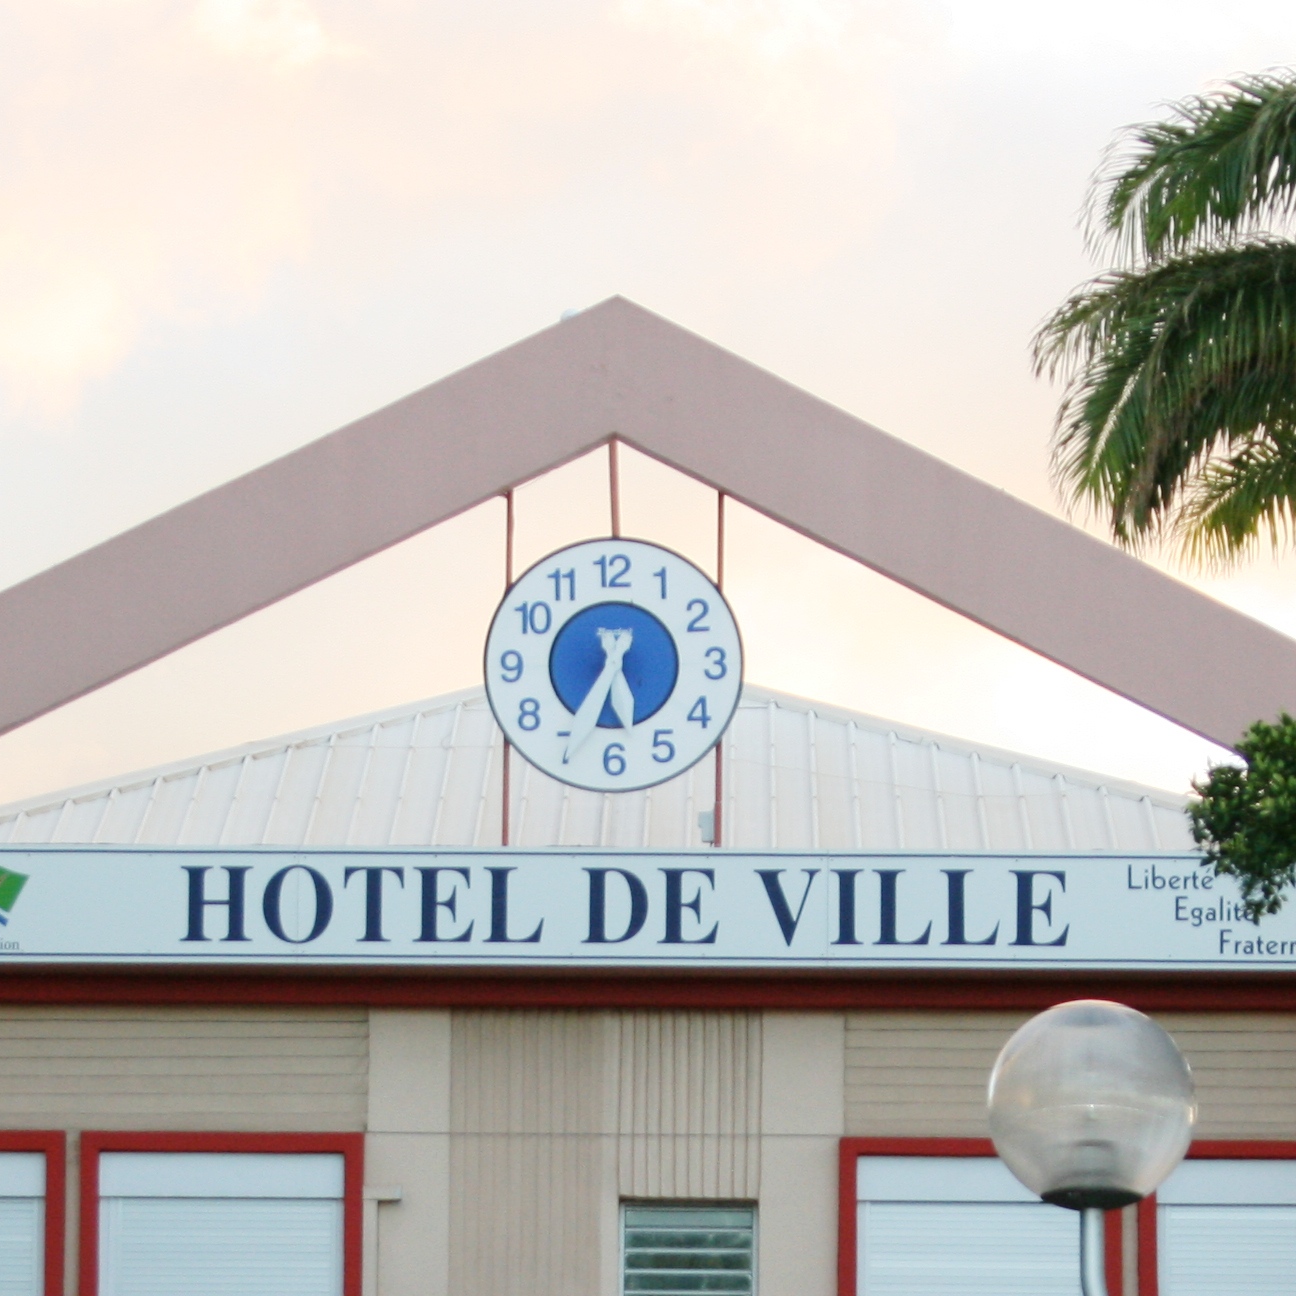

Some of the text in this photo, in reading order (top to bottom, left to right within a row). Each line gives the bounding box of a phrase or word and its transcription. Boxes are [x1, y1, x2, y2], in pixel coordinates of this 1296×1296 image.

[547, 568, 576, 602] 11
[593, 554, 631, 588] 12
[653, 566, 667, 600] 1
[514, 601, 552, 635] 10
[686, 598, 710, 633] 2
[500, 649, 524, 683] 9
[704, 646, 727, 681] 3
[517, 697, 541, 732] 8
[686, 695, 711, 729] 4
[602, 742, 626, 776] 6
[652, 729, 676, 764] 5
[1127, 864, 1215, 890] Liberté
[179, 864, 1070, 947] HOTEL DE VILLE
